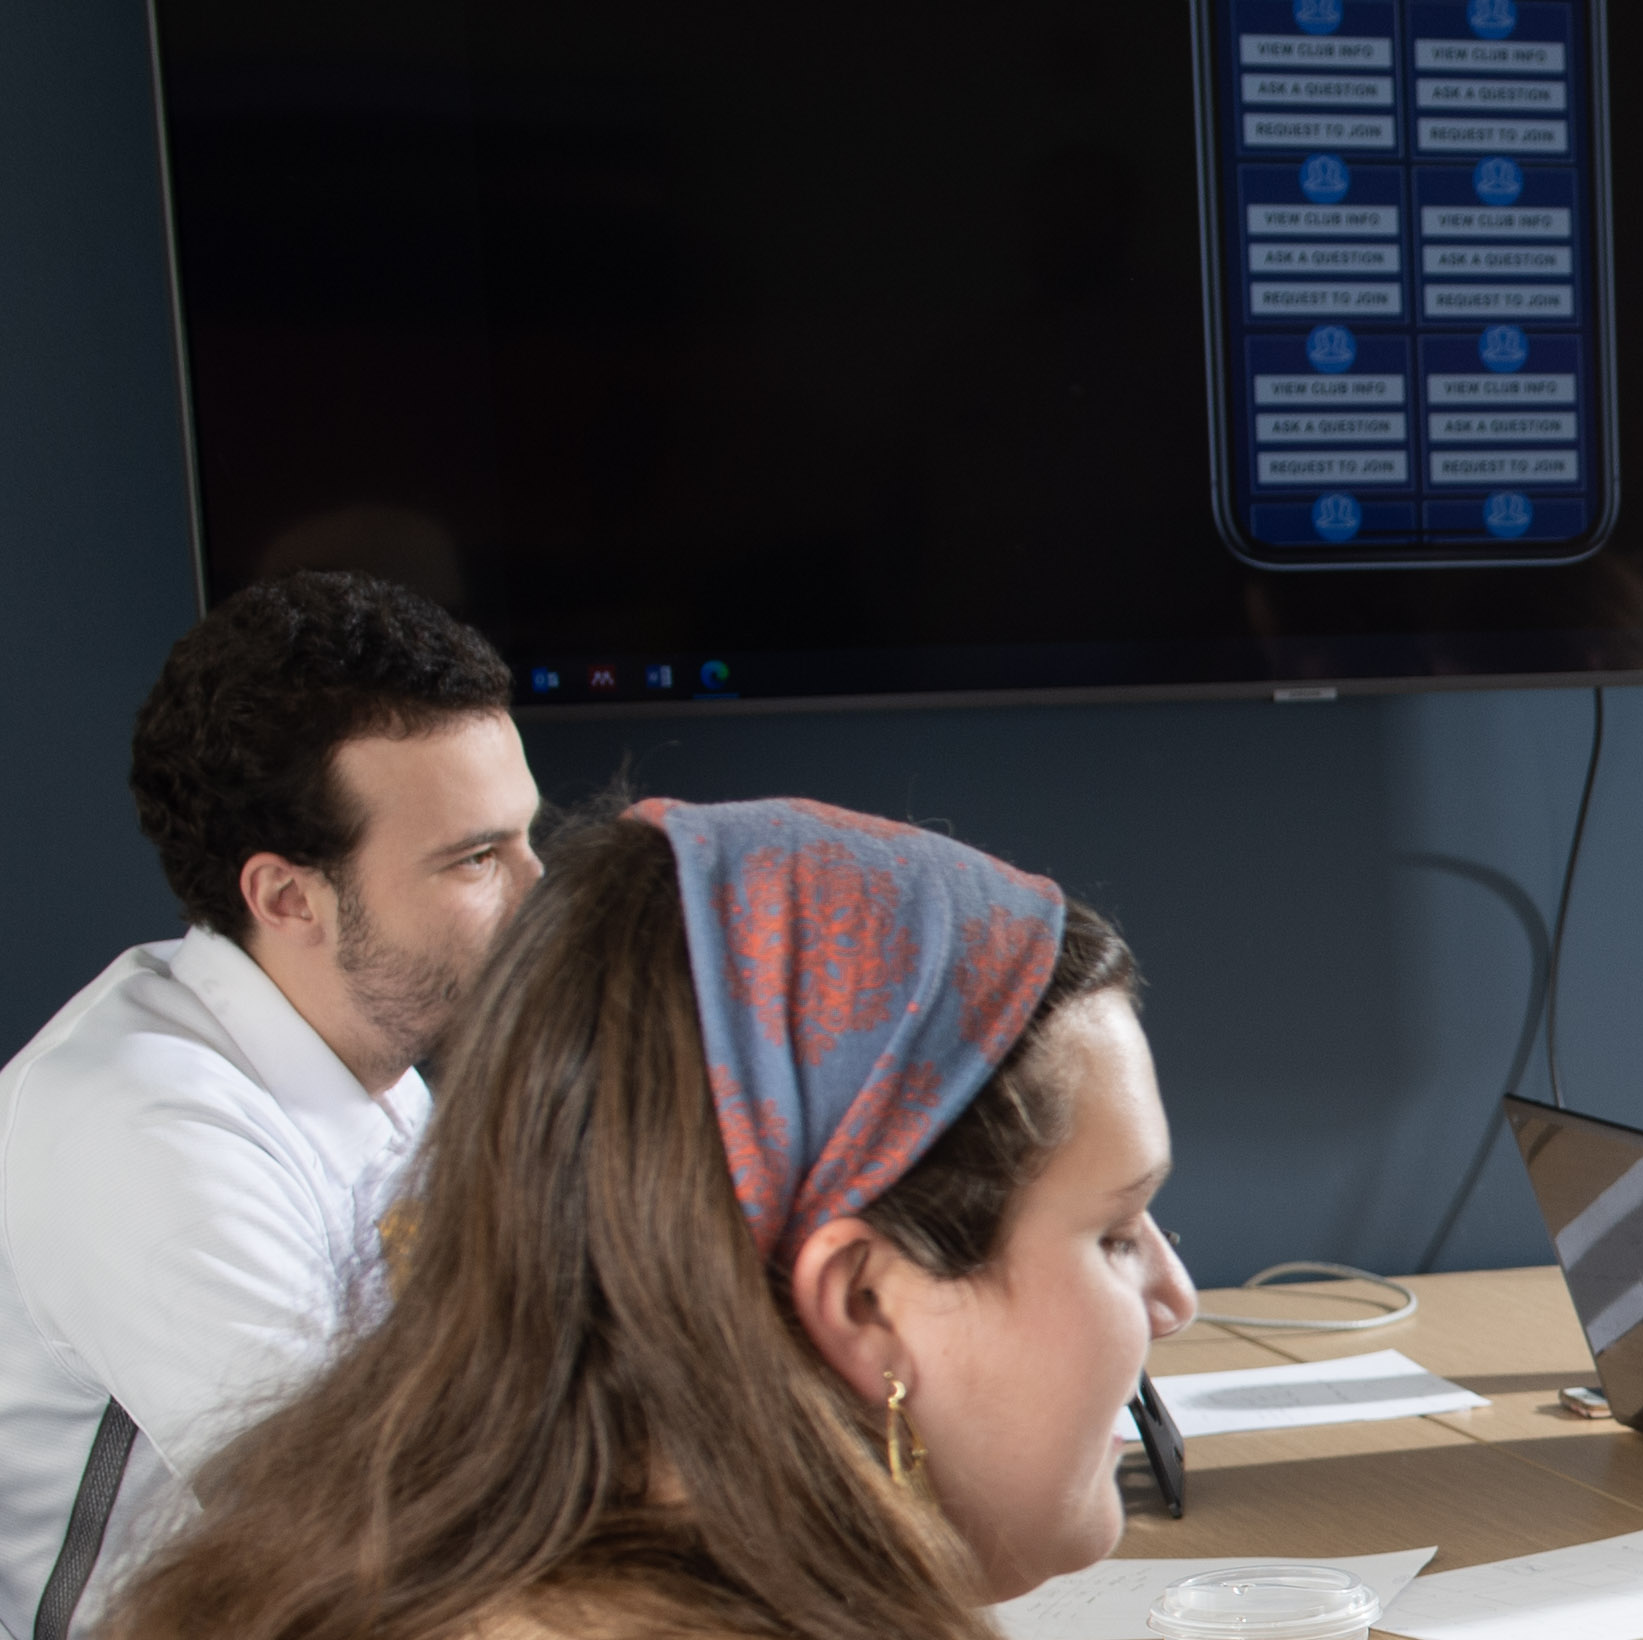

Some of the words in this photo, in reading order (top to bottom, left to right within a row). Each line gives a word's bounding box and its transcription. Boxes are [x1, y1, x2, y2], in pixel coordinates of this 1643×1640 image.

[1258, 44, 1293, 57] VIEW
[1299, 44, 1334, 58] CLUB
[1338, 45, 1372, 58] INFO
[1432, 49, 1467, 62] VIEW
[1473, 49, 1508, 62] CLUB
[1513, 50, 1547, 63] INFO
[1258, 82, 1287, 97] ASK
[1290, 82, 1300, 97] A
[1304, 83, 1377, 98] QUESTION
[1432, 87, 1461, 101] ASK
[1464, 87, 1474, 101] A
[1478, 87, 1552, 102] QUESTION
[1256, 123, 1321, 138] REQUEST
[1324, 124, 1344, 138] TO
[1348, 124, 1381, 139] JOIN
[1430, 127, 1495, 142] REQUEST
[1499, 128, 1518, 142] TO
[1523, 128, 1556, 143] JOIN
[1265, 213, 1300, 225] VIEW
[1306, 213, 1341, 225] CLUB
[1346, 213, 1380, 225] INFO
[1439, 214, 1474, 226] VIEW
[1480, 214, 1515, 226] CLUB
[1520, 214, 1554, 226] INFO
[1265, 251, 1294, 265] ASK
[1297, 251, 1307, 265] A
[1310, 251, 1384, 265] QUESTION
[1439, 252, 1468, 267] ASK
[1471, 252, 1481, 267] A
[1484, 252, 1558, 267] QUESTION
[1263, 291, 1327, 305] REQUEST
[1331, 291, 1351, 305] TO
[1355, 291, 1388, 305] JOIN
[1436, 293, 1501, 307] REQUEST
[1505, 293, 1524, 307] TO
[1529, 293, 1562, 307] JOIN
[1271, 382, 1307, 394] VIEW
[1313, 382, 1348, 394] CLUB
[1352, 381, 1386, 394] INFO
[1445, 381, 1480, 394] VIEW
[1486, 381, 1521, 393] CLUB
[1525, 380, 1559, 393] INFO
[1273, 419, 1301, 433] ASK
[1304, 419, 1315, 433] A
[1318, 419, 1392, 433] QUESTION
[1445, 419, 1474, 433] ASK
[1477, 419, 1487, 433] A
[1490, 419, 1564, 432] QUESTION
[1270, 460, 1334, 473] REQUEST
[1338, 459, 1358, 473] TO
[1362, 459, 1395, 473] JOIN
[1442, 459, 1507, 472] REQUEST
[1510, 458, 1530, 472] TO
[1534, 458, 1567, 472] JOIN
